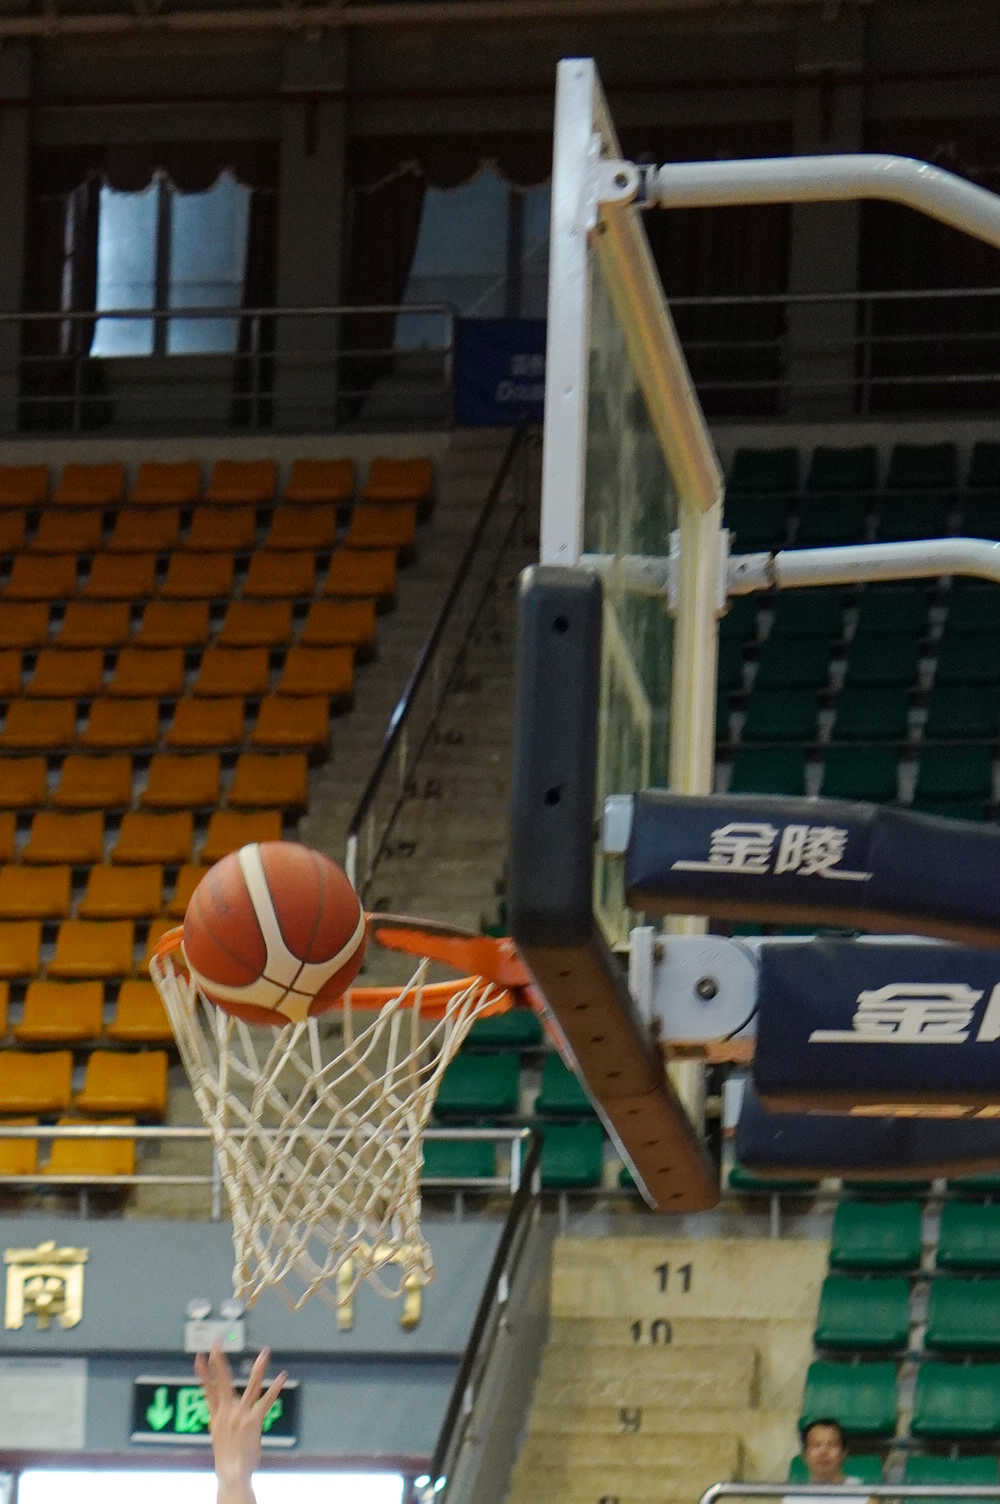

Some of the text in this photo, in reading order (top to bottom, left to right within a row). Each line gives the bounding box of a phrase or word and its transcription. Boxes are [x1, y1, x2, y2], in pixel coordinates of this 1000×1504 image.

[672, 822, 874, 882] 金陵
[809, 983, 1000, 1044] 金
[655, 1261, 693, 1293] 11
[630, 1319, 672, 1344] 10
